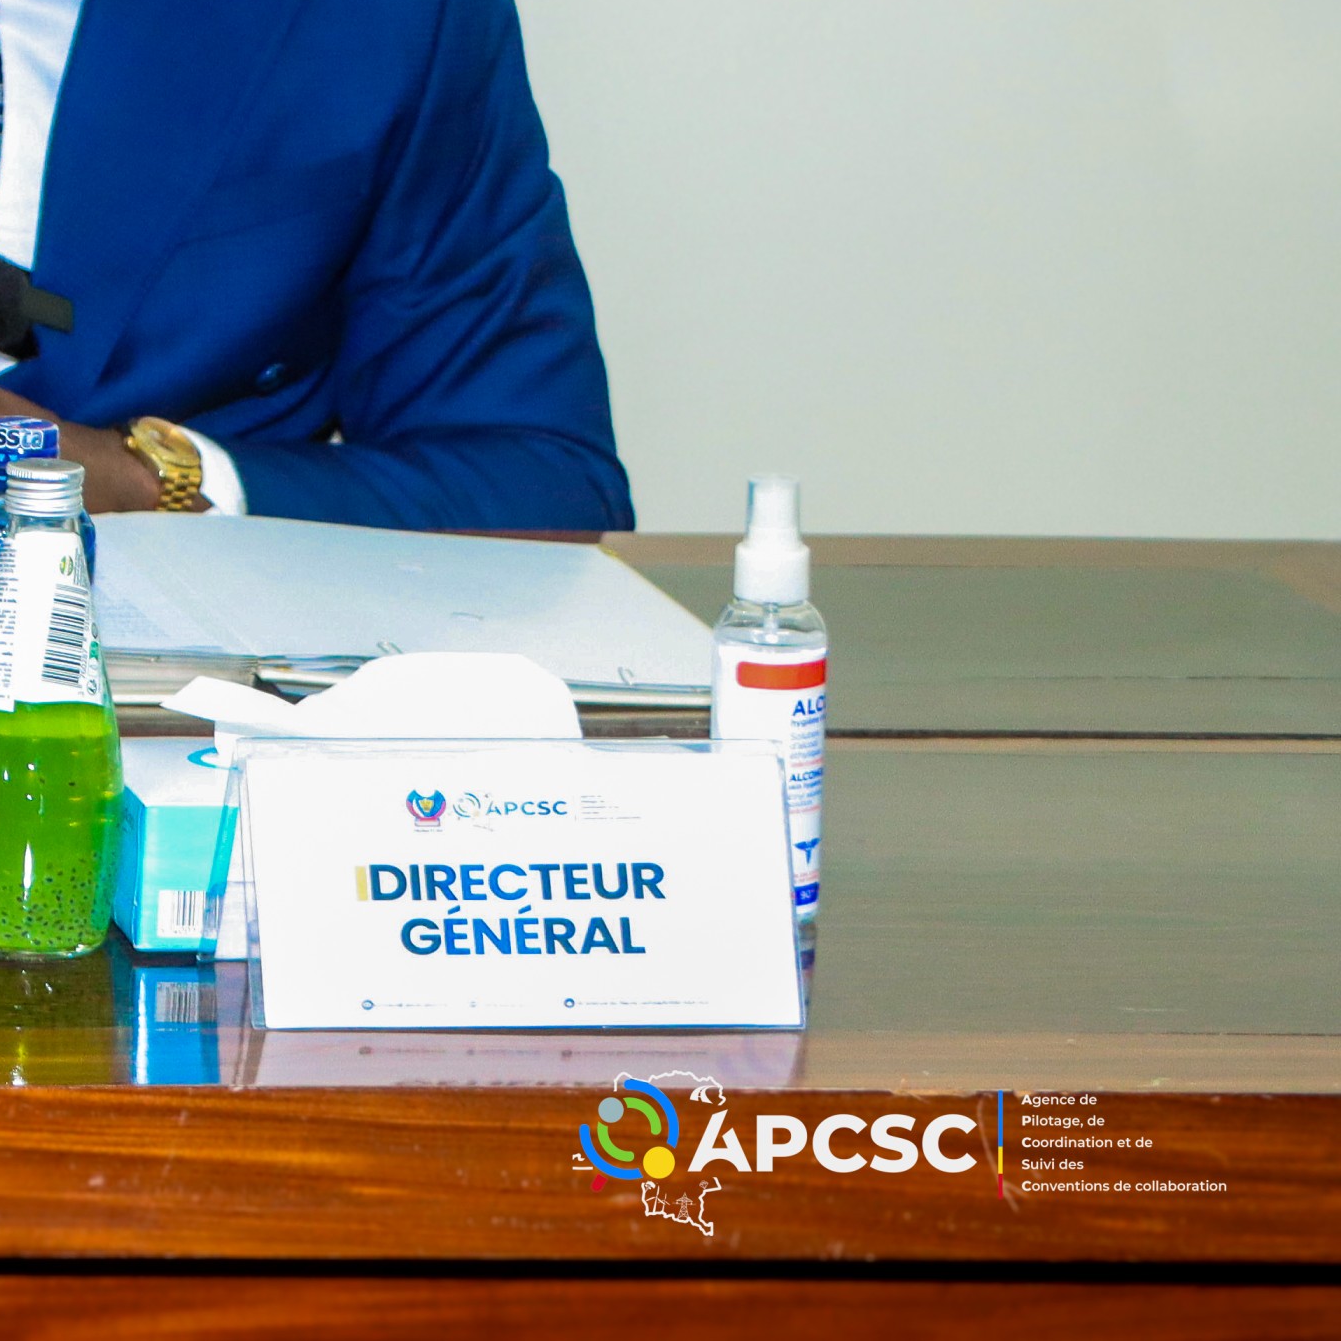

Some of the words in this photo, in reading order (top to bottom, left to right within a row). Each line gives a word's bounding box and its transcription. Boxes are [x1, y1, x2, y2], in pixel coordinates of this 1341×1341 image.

[485, 800, 568, 816] APCSC
[369, 863, 667, 901] DIRECTEUR
[400, 904, 647, 956] GÉNÉRAL
